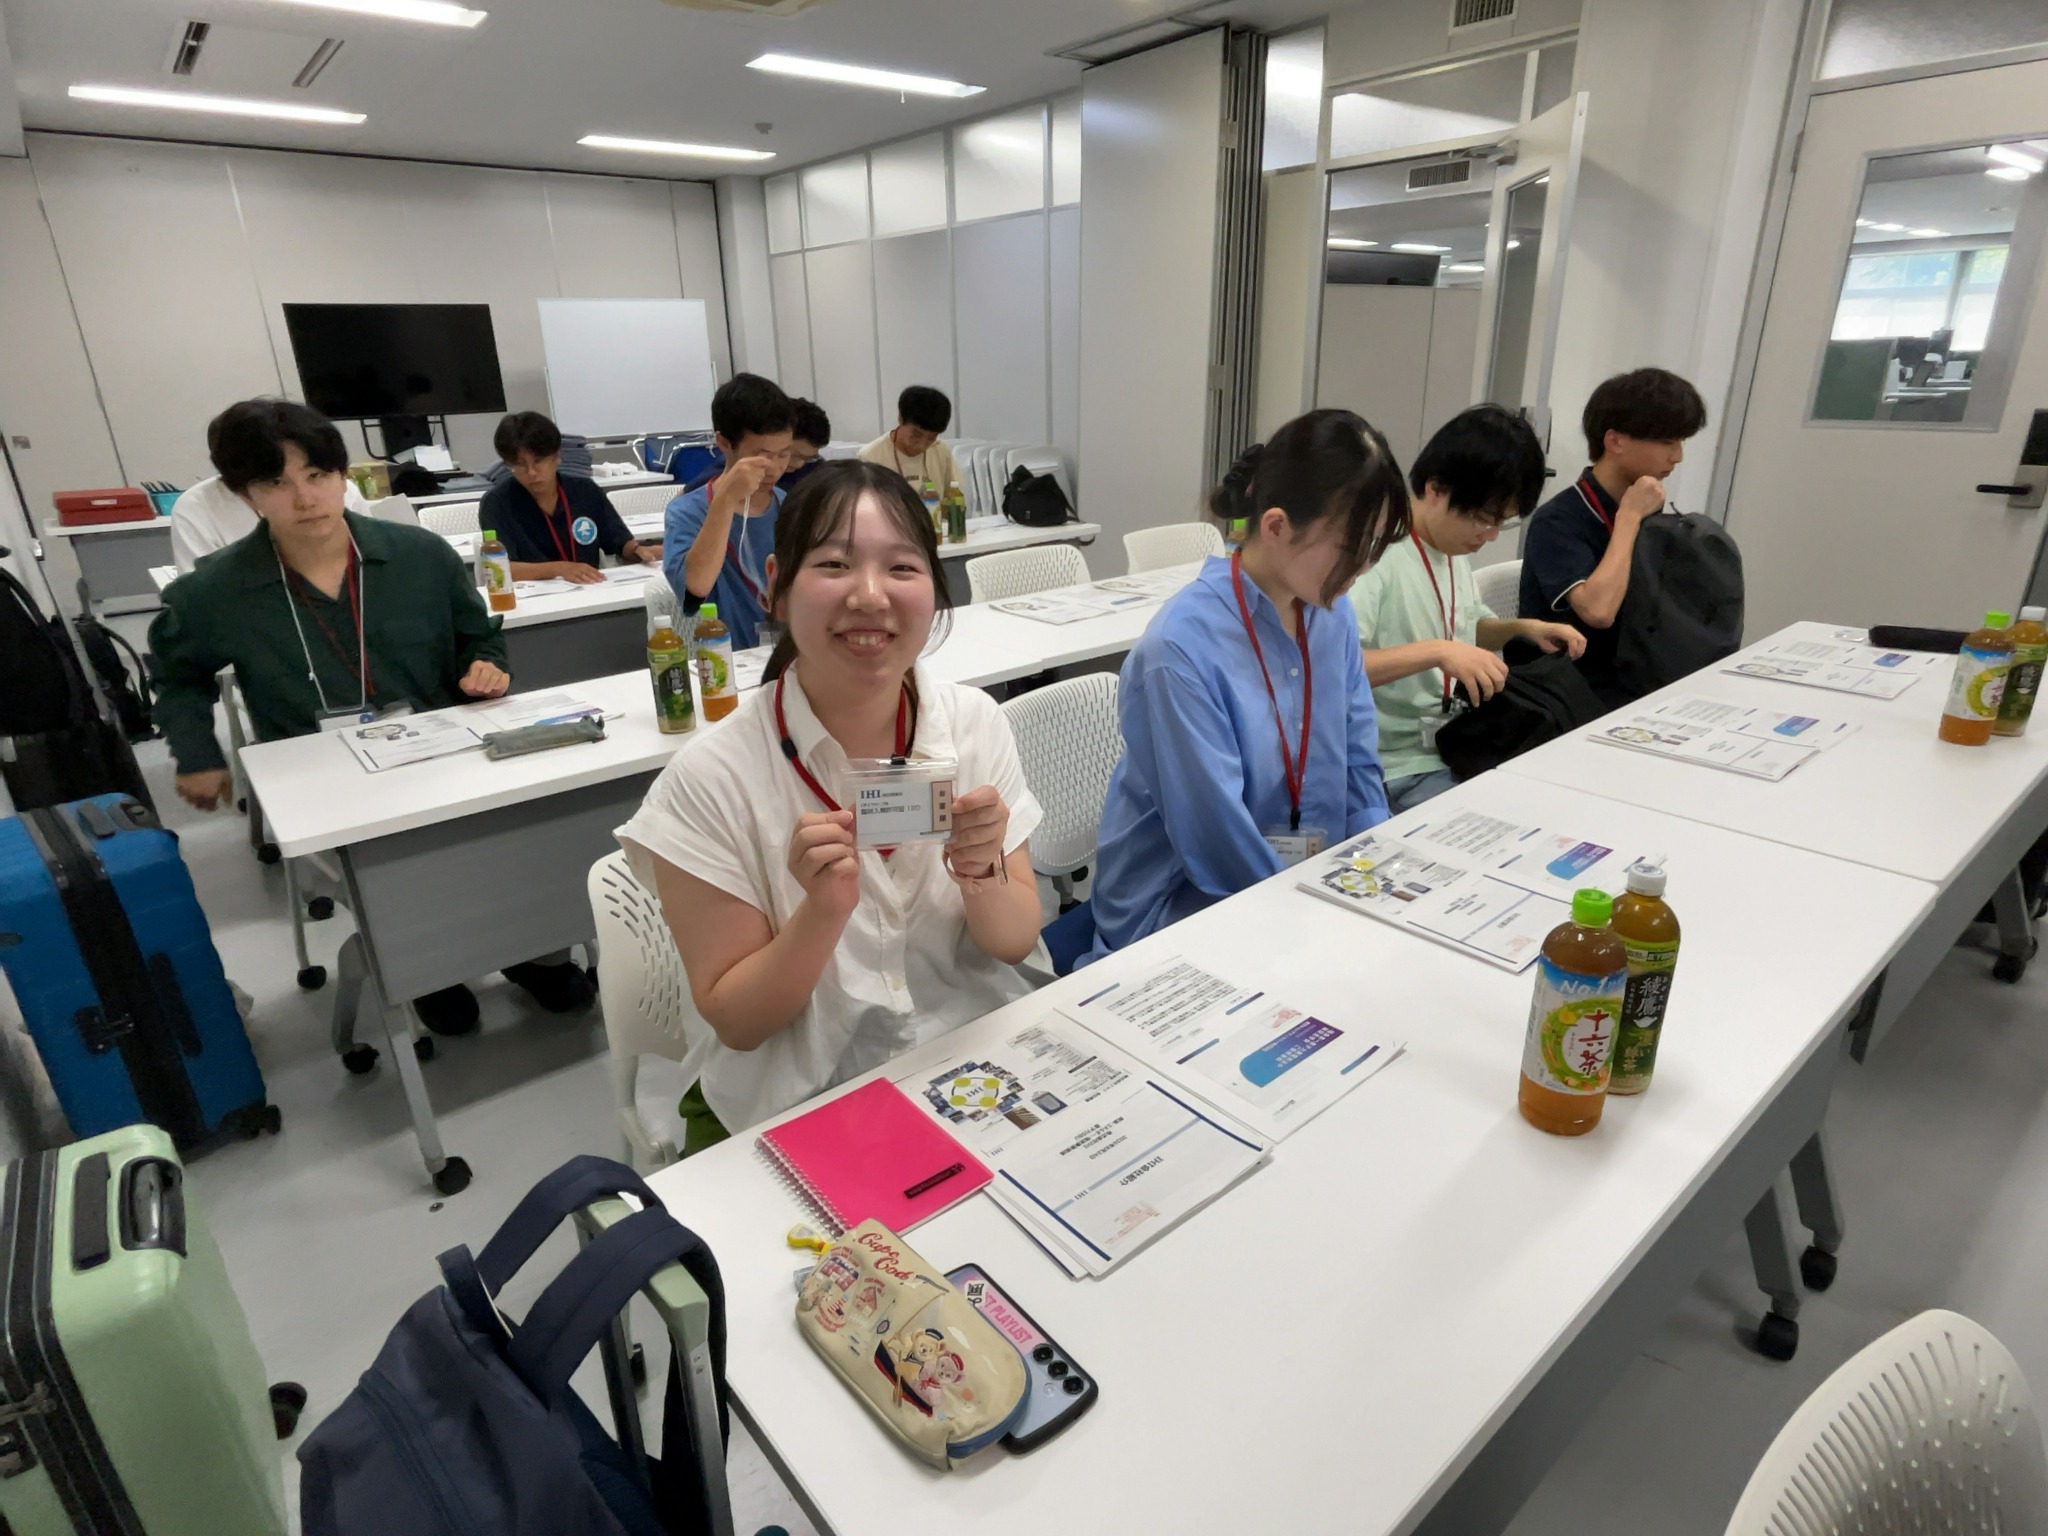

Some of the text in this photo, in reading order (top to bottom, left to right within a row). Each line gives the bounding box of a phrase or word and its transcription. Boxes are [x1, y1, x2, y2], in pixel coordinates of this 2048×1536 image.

[861, 790, 880, 799] IHI
[1578, 1009, 1610, 1077] 十六茶
[966, 1086, 984, 1098] IHI
[1074, 1190, 1088, 1201] IHI
[858, 1233, 899, 1257] Cape
[875, 1257, 914, 1280] Cod
[989, 1305, 1033, 1344] PLAYLIST
